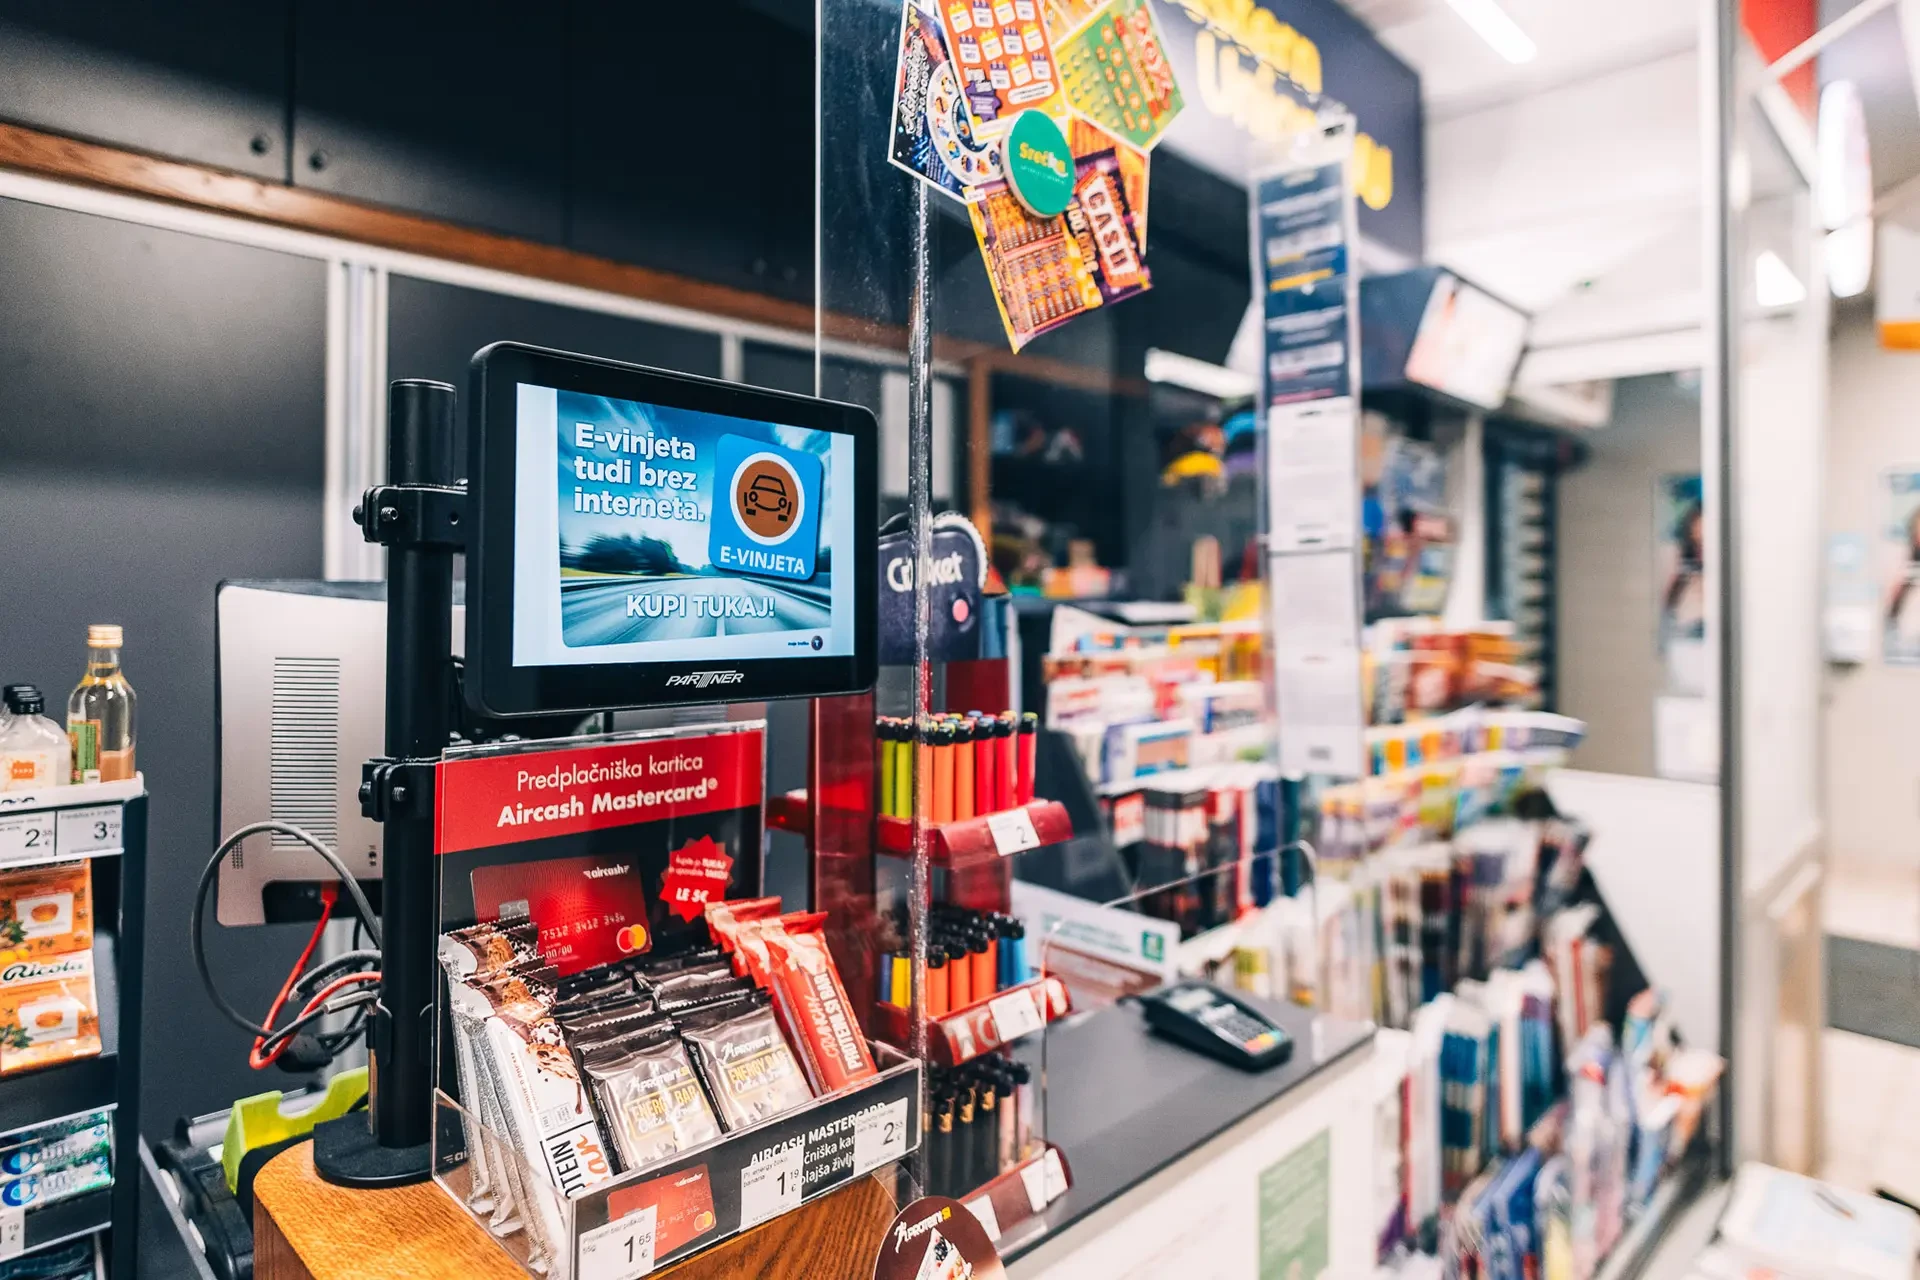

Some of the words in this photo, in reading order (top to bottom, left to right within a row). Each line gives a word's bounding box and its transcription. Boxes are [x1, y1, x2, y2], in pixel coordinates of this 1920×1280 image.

[1087, 191, 1128, 268] CASH
[575, 422, 696, 461] E-vinjeta
[574, 456, 632, 484] tudi
[640, 461, 697, 490] brez
[574, 486, 705, 521] interneta.
[720, 546, 806, 575] E-VINJETA
[626, 594, 687, 618] KUPI
[692, 594, 777, 618] TUKAJ!
[665, 670, 745, 689] PARTNER
[517, 757, 643, 793] Predplačniška
[649, 754, 704, 776] kartica
[496, 795, 585, 828] Aircash
[25, 828, 40, 848] 2
[94, 821, 108, 840] 3
[1015, 826, 1029, 844] 2
[590, 864, 624, 879] aircash
[676, 887, 690, 901] LE
[541, 925, 569, 940] 7512
[3, 959, 84, 981] Ricola
[804, 994, 840, 1058] CRUNCHY
[728, 1061, 765, 1084] ENERGY
[882, 1121, 895, 1146] 2
[750, 1134, 806, 1166] AIRCASH
[776, 1171, 786, 1197] 1
[790, 1169, 800, 1180] 19
[624, 1235, 635, 1263] 1
[638, 1232, 652, 1245] 65
